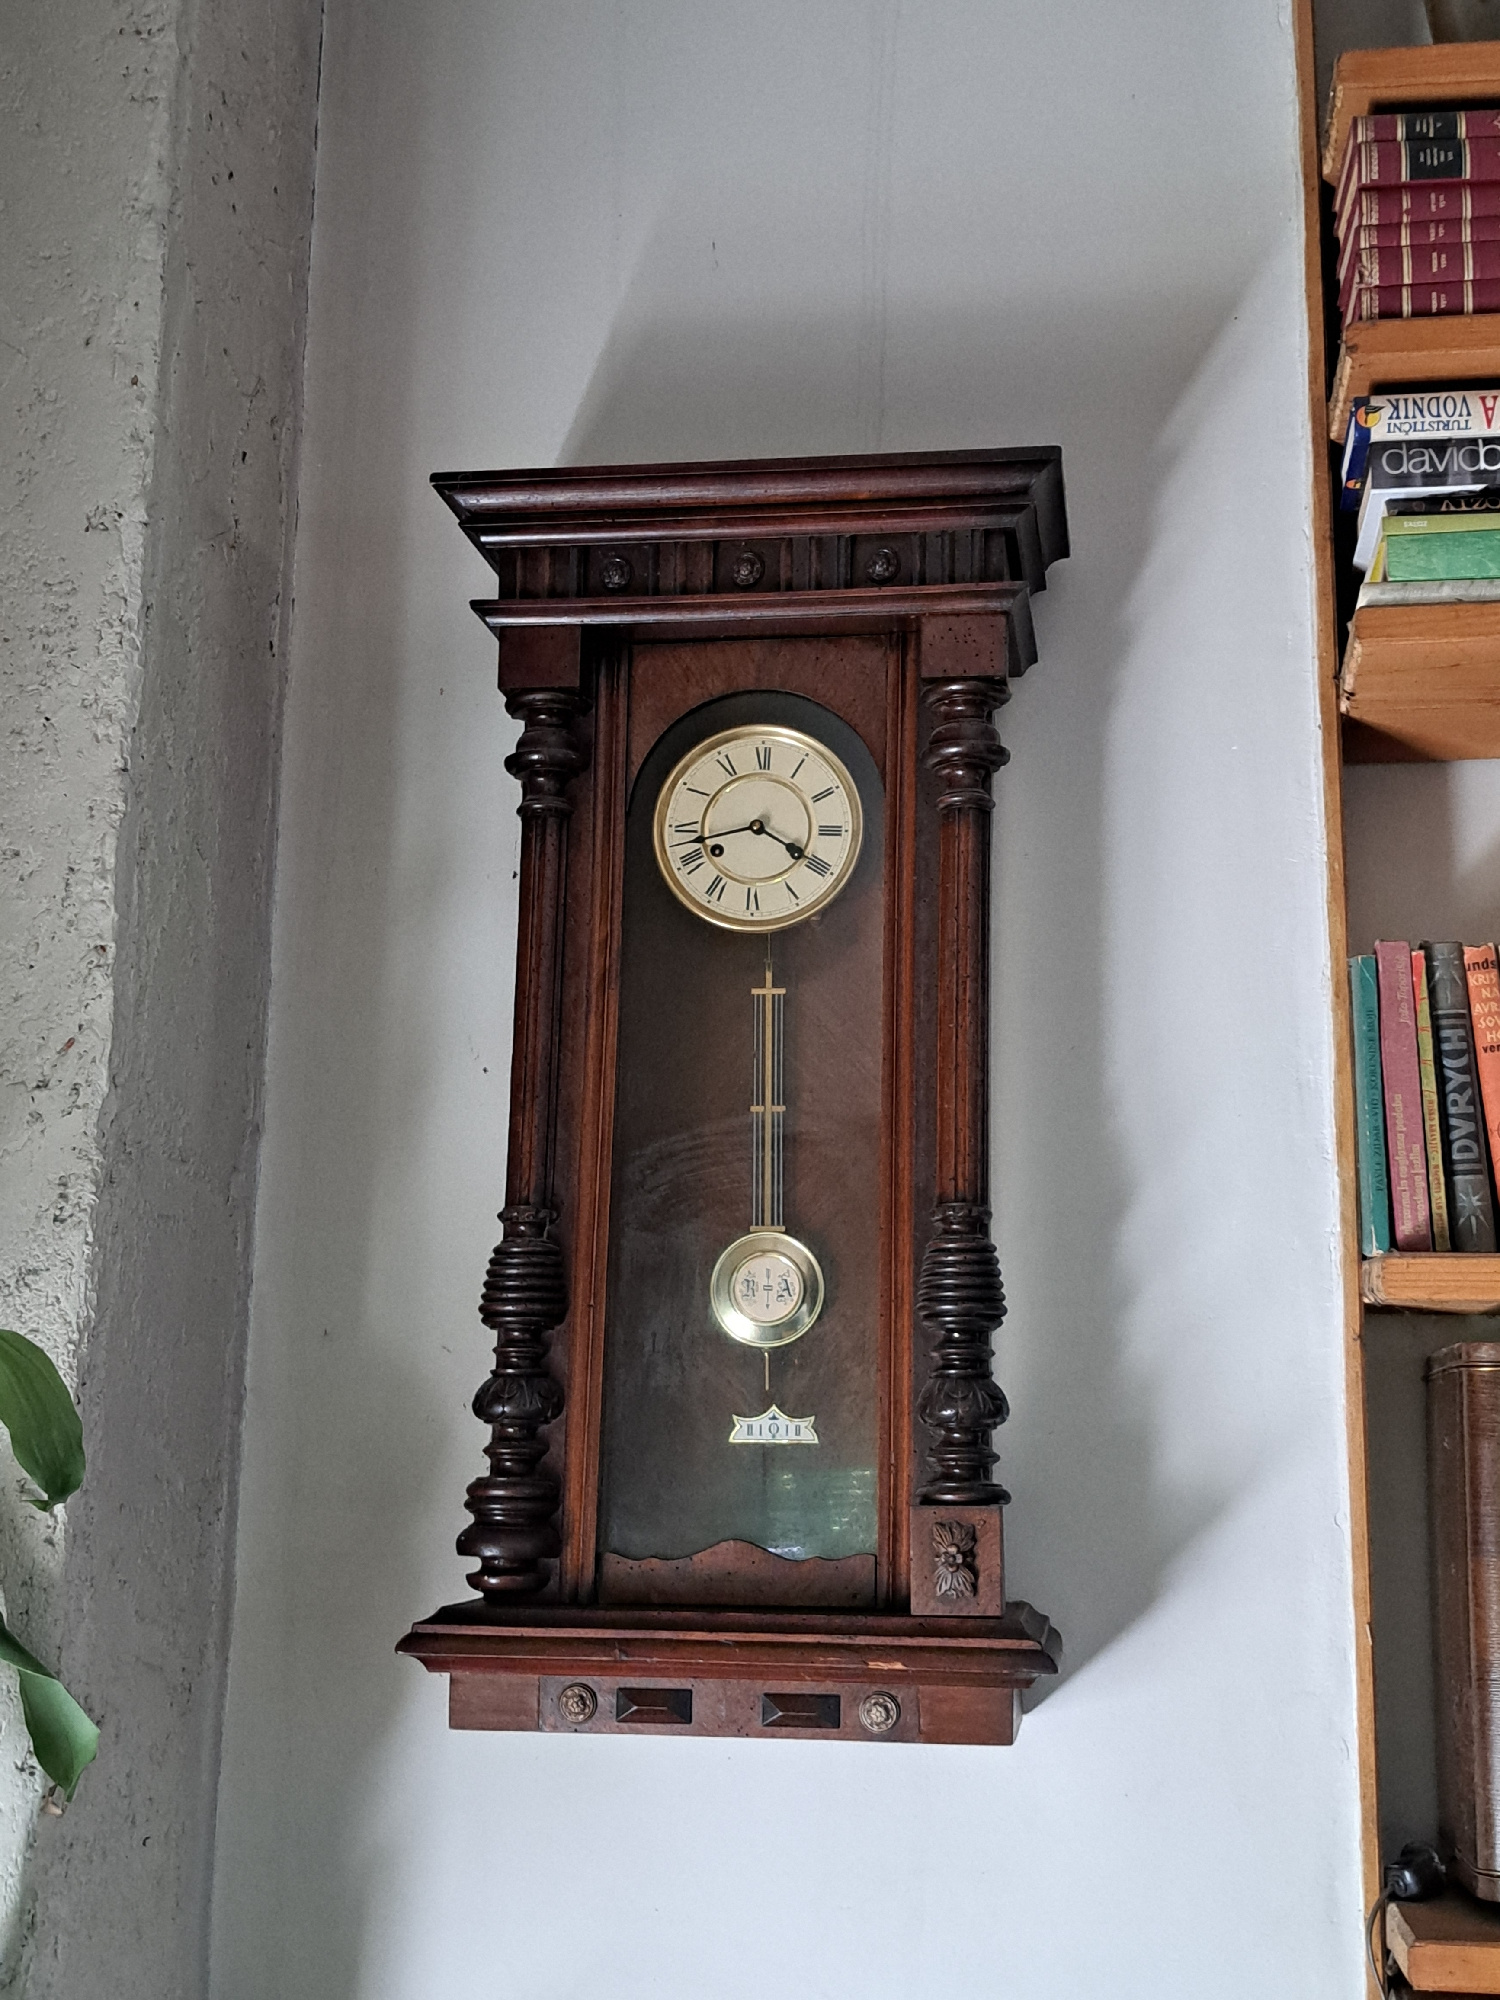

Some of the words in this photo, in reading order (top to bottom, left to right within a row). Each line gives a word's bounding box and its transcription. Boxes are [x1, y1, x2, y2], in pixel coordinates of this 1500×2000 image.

[1386, 395, 1472, 420] VODNIK
[1479, 395, 1500, 429] A
[1387, 419, 1471, 435] TURISTIČNI
[790, 758, 805, 779] I
[811, 786, 835, 803] II
[818, 825, 843, 836] III
[1439, 1028, 1479, 1161] DVRYCH
[1392, 1094, 1406, 1131] podoba
